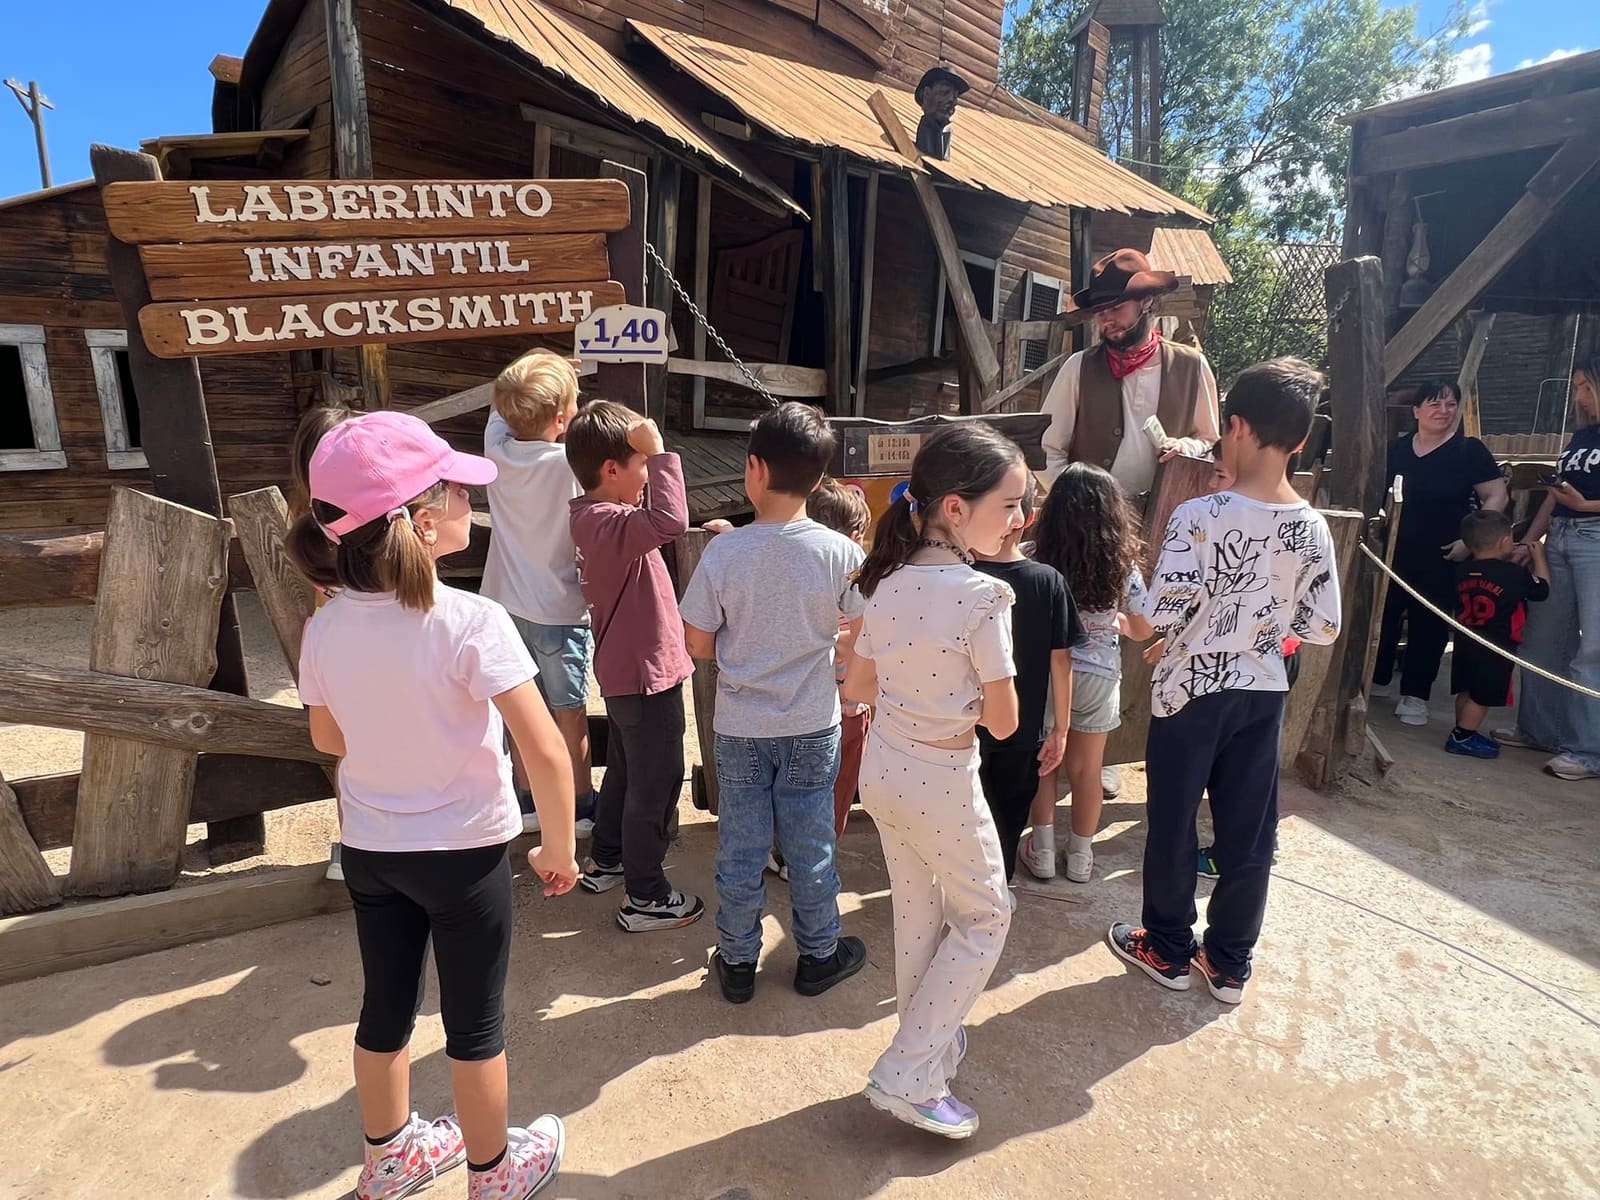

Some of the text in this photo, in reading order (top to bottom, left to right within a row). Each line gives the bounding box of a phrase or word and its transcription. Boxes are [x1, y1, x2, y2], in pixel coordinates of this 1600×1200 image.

[190, 183, 553, 223] LABERINTO
[244, 240, 530, 282] INFANTIL
[180, 291, 593, 346] BLACKSMITH
[593, 318, 660, 346] 1,40
